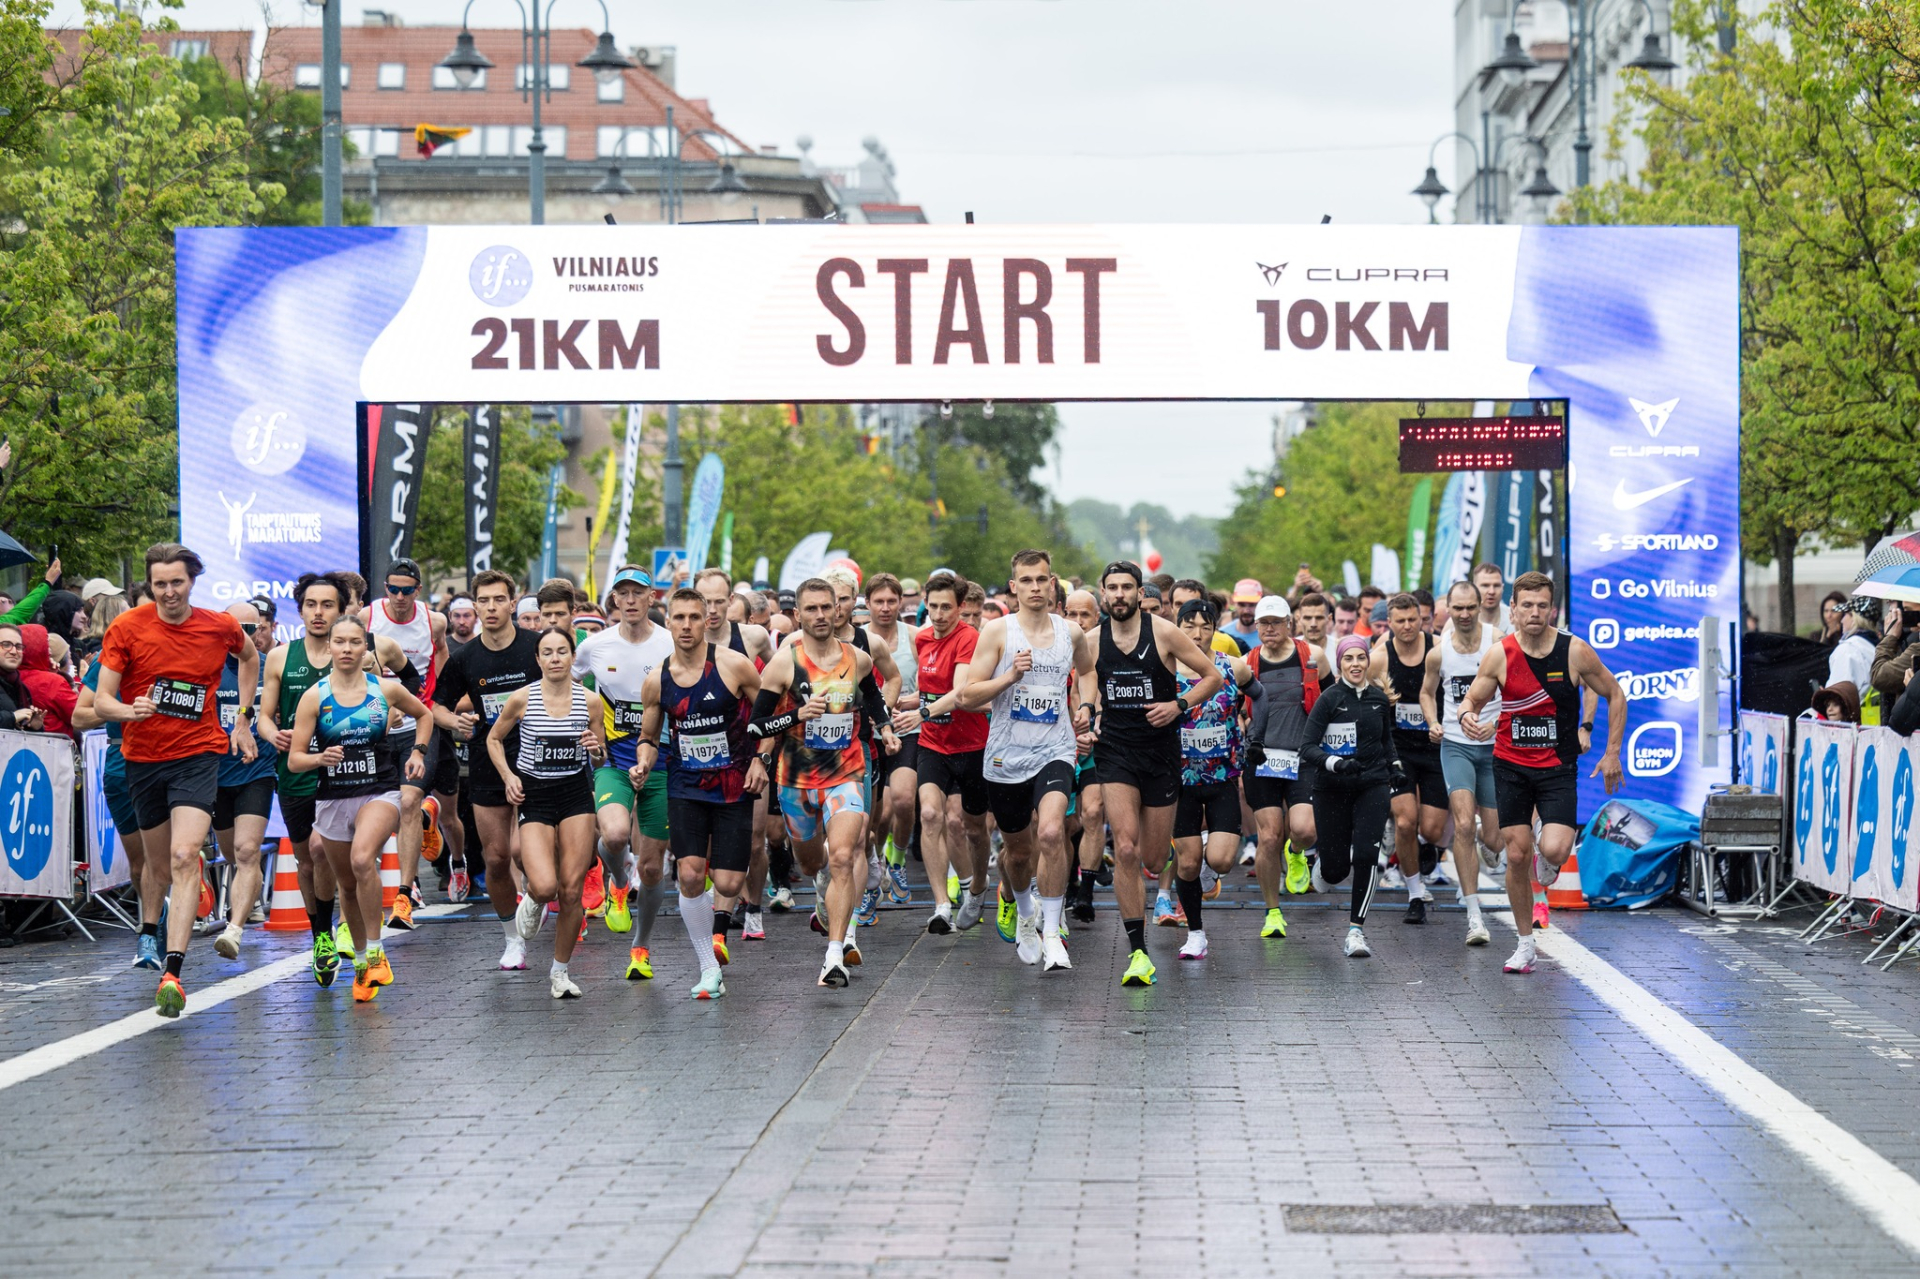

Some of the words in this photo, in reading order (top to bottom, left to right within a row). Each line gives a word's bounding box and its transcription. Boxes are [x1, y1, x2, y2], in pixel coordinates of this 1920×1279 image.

[553, 256, 659, 277] VILNIAUS
[1307, 268, 1449, 282] CUPRA
[569, 284, 644, 292] PUSMARATONIS
[816, 257, 1117, 367] START
[1256, 299, 1449, 351] 10KM
[471, 317, 660, 370] 21KM
[1609, 445, 1699, 457] CUPRA
[246, 513, 322, 528] TARPTAUTINIS
[248, 527, 322, 543] MARATONAS
[1621, 534, 1719, 550] SPORTLAND
[212, 581, 298, 600] GARM
[1618, 579, 1649, 598] Go
[1651, 579, 1718, 598] Vilnius
[1115, 686, 1144, 697] 20873
[163, 690, 195, 707] 21080
[1025, 698, 1052, 710] 11847
[765, 715, 792, 730] NORD
[818, 726, 846, 738] 12107
[1520, 726, 1547, 737] 21360
[1192, 737, 1218, 748] 11465
[545, 748, 575, 759] 21322
[690, 745, 718, 757] 11972
[1635, 748, 1674, 759] LEMON
[336, 760, 366, 773] 21218
[1635, 758, 1662, 768] GYM
